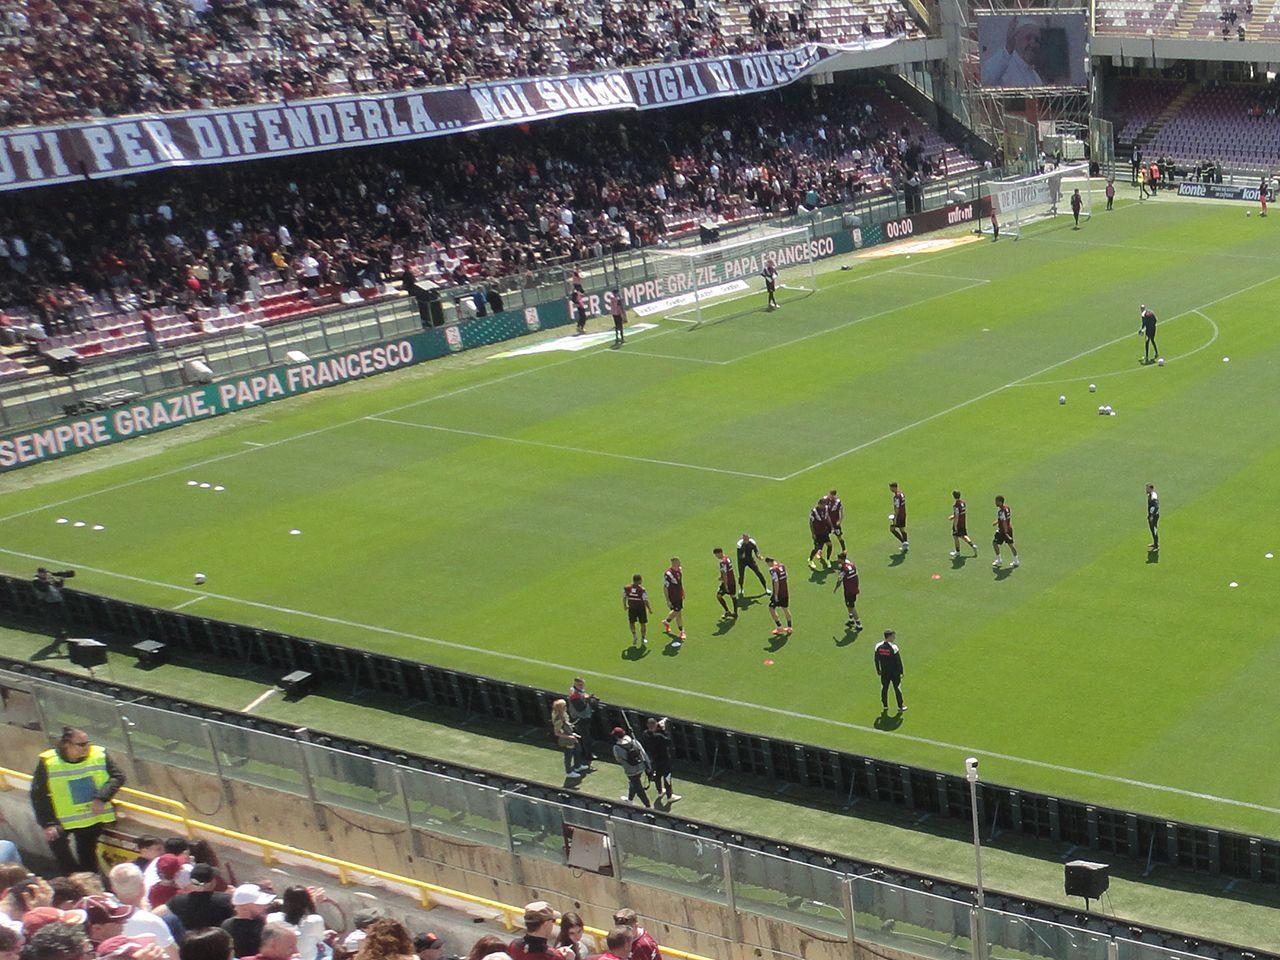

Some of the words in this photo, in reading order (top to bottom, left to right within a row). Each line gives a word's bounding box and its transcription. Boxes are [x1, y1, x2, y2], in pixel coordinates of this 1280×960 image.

[82, 120, 185, 171] PER
[471, 84, 537, 121] NOI
[536, 72, 633, 110] SIAMO
[633, 62, 707, 104] FIGLI
[708, 58, 739, 91] DI
[887, 218, 913, 239] 00:00
[604, 278, 664, 310] SMPRE
[725, 256, 759, 279] PAPA
[0, 416, 111, 467] SEMPRE
[114, 390, 216, 436] GRAZIE,
[220, 374, 285, 408] PAPA
[286, 340, 413, 391] FRANCESCO
